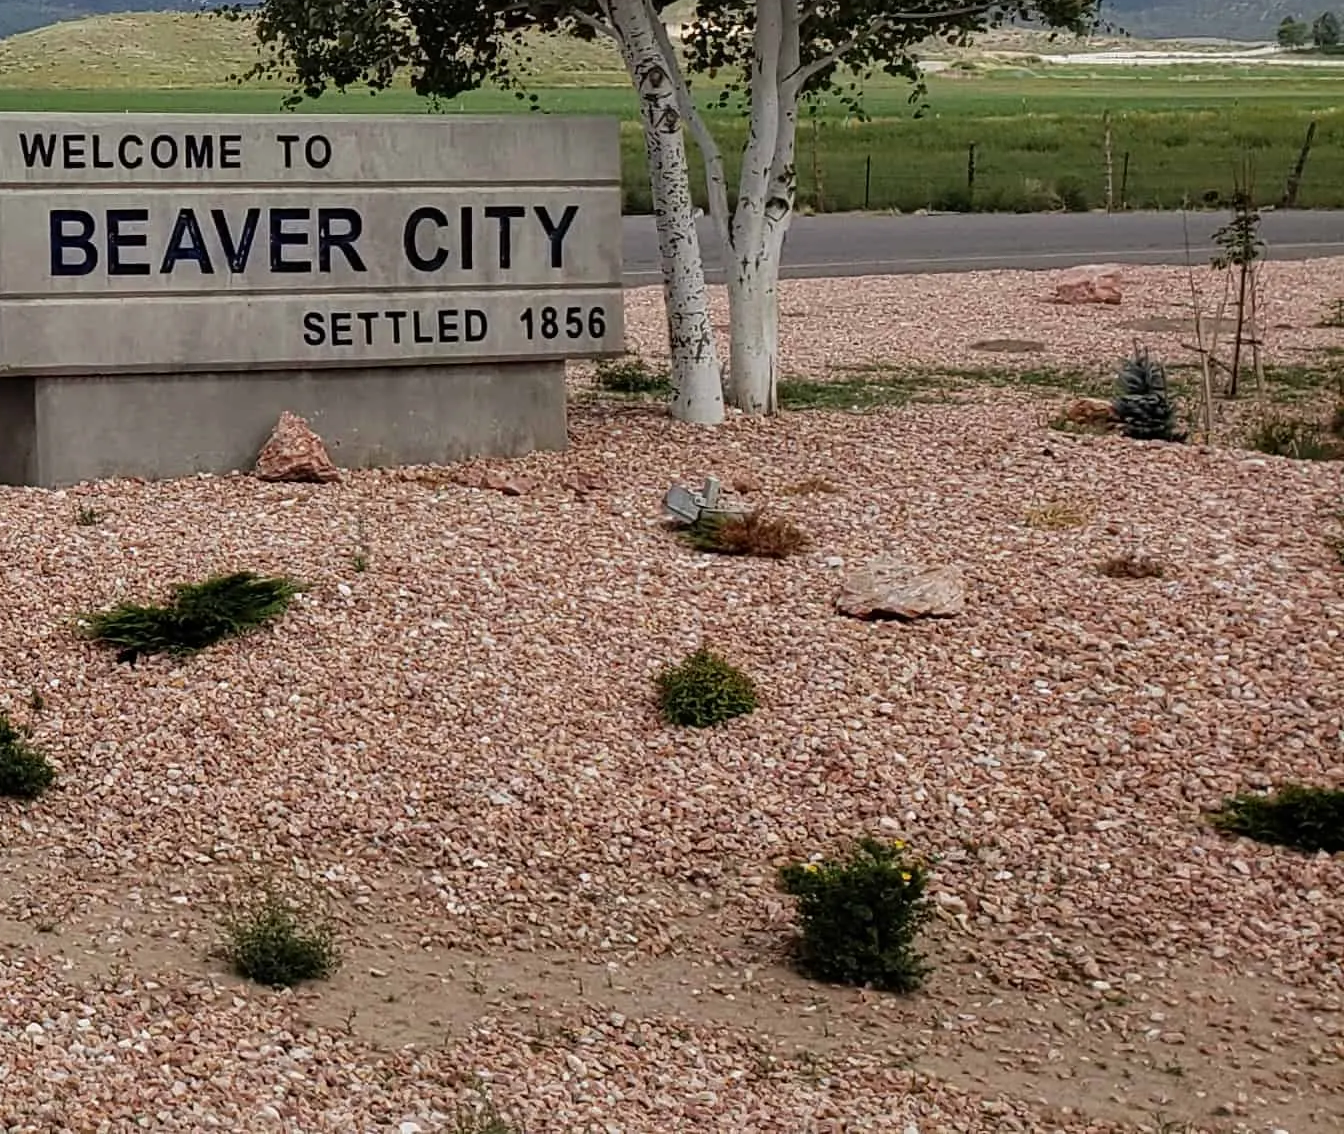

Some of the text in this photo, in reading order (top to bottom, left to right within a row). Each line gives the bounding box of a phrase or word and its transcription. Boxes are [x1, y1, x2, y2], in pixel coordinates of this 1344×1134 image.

[19, 133, 332, 169] WELCOME TO
[49, 206, 579, 276] BEAVER CITY
[303, 306, 606, 346] SETTLED 1856
